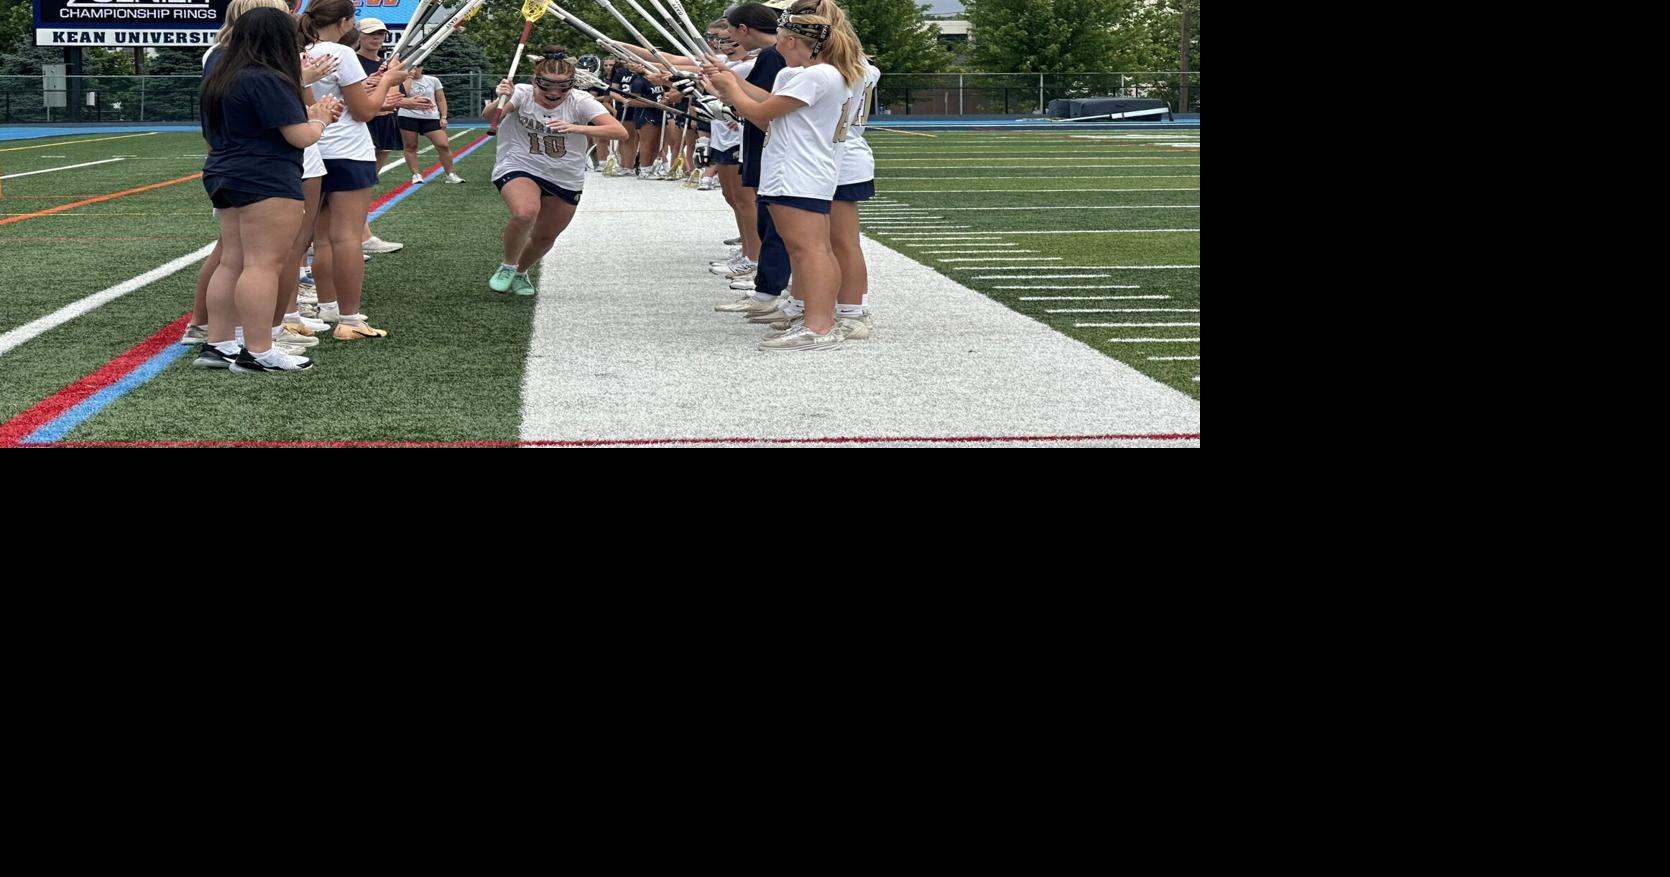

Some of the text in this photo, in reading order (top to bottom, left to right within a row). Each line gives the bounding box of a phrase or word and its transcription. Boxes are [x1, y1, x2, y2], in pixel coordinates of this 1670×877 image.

[59, 8, 217, 19] CHAMPIONSHIP RINGS
[52, 31, 106, 43] KEAN
[527, 132, 567, 159] 10
